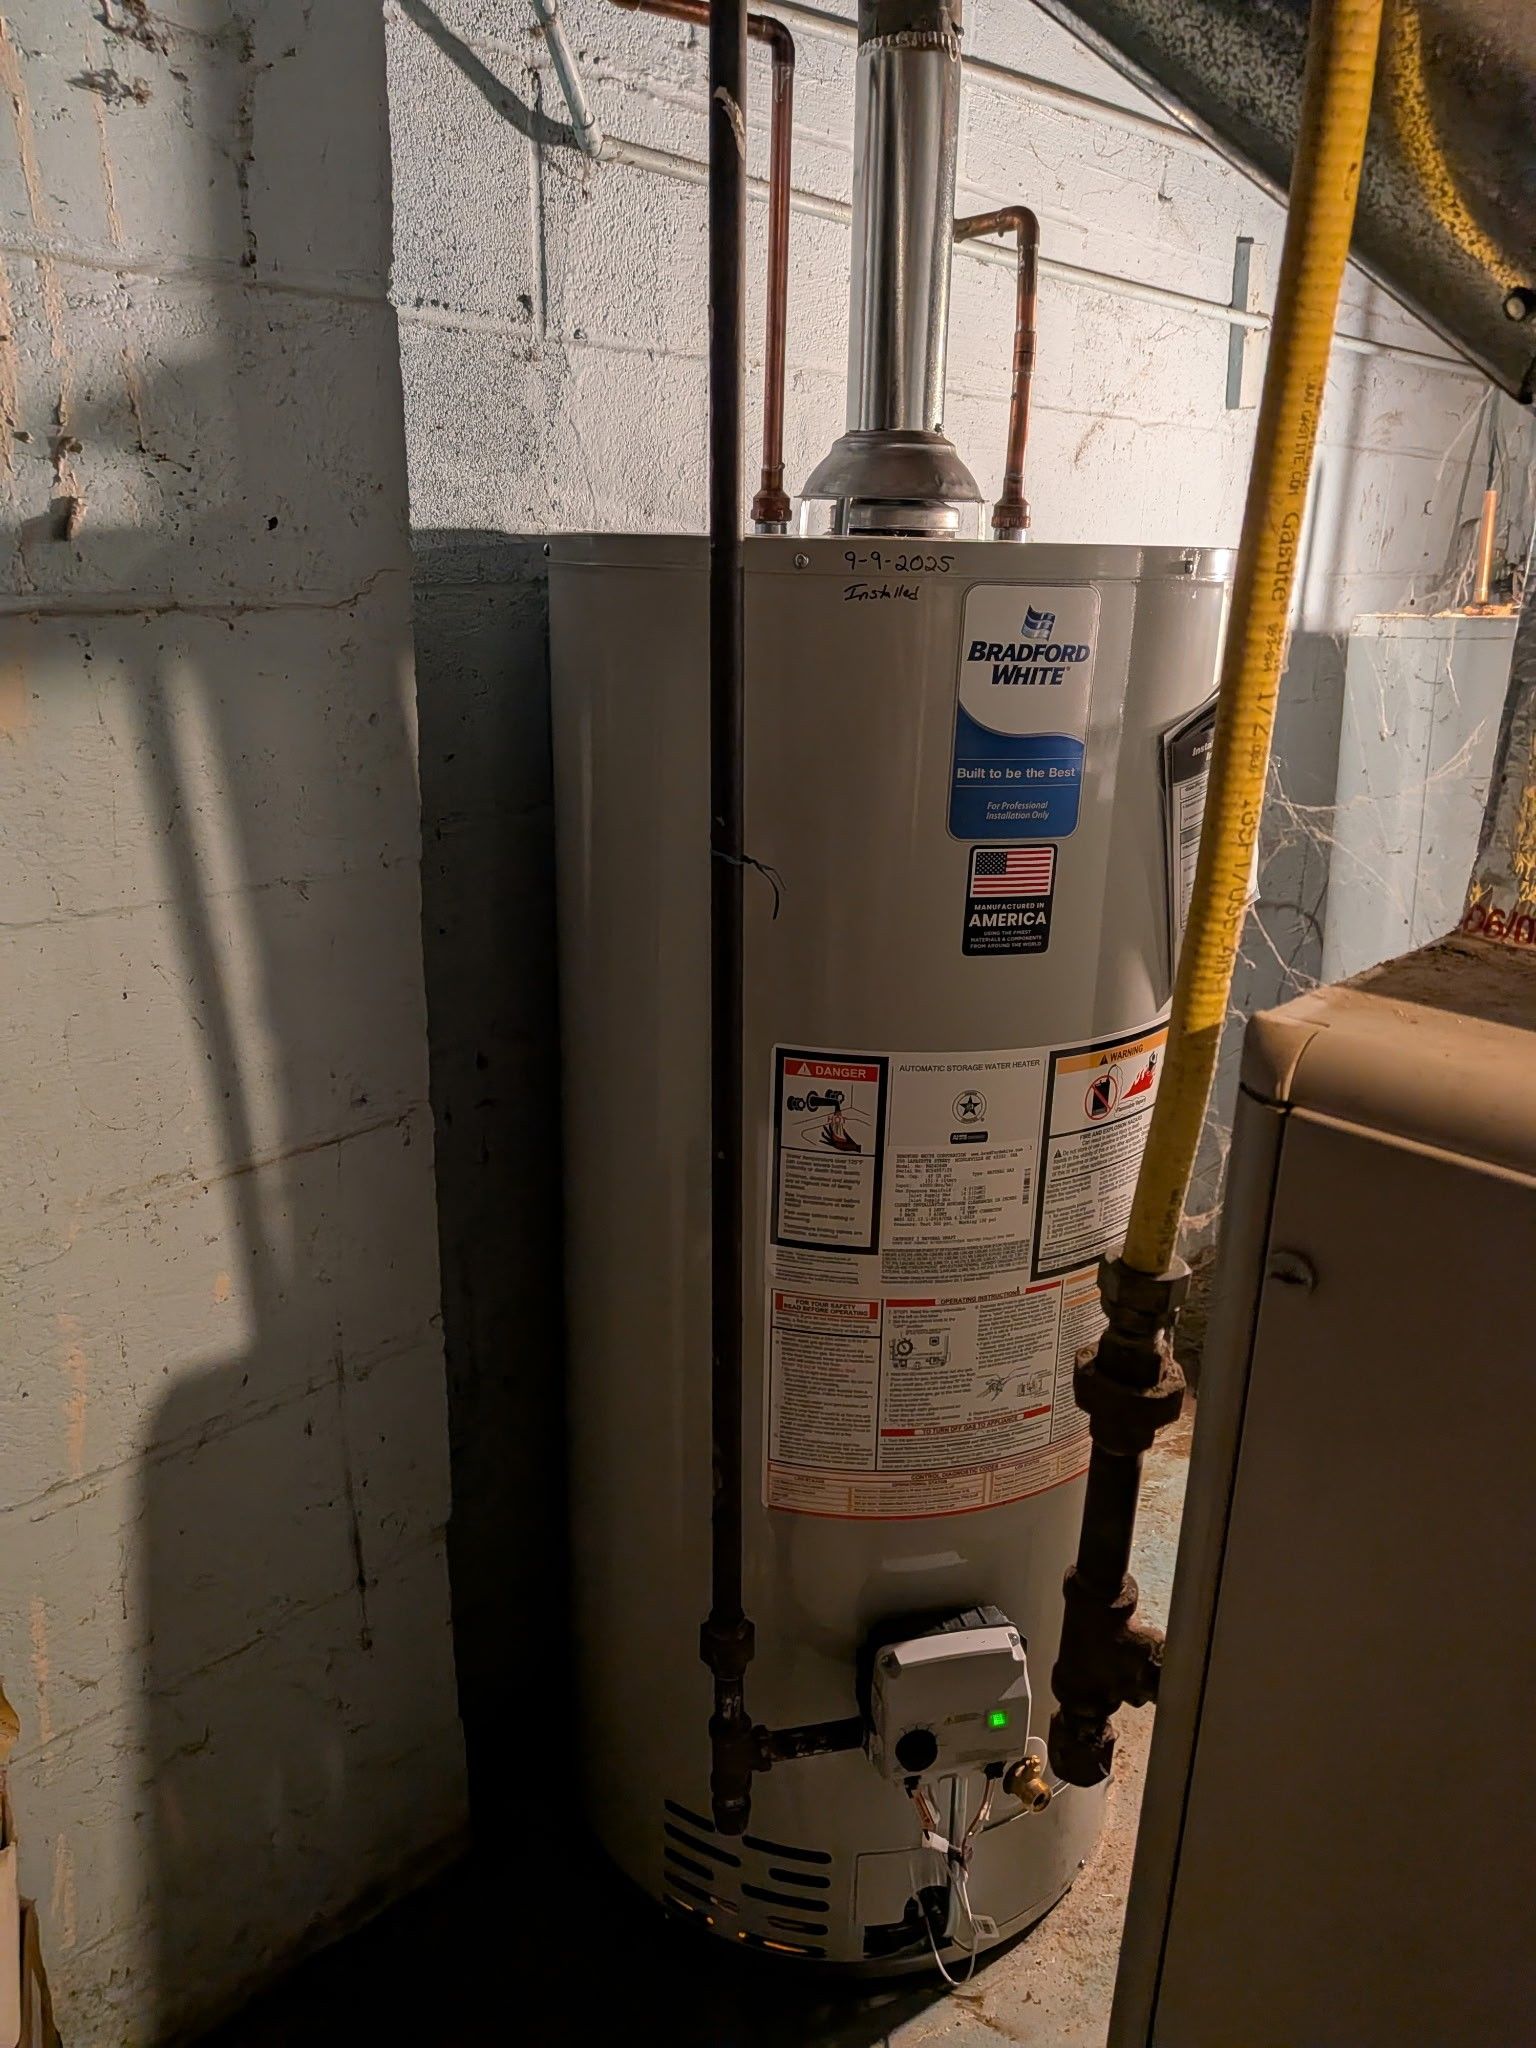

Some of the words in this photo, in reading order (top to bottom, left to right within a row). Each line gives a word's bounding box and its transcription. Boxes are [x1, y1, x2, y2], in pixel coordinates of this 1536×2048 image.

[844, 551, 954, 572] 9-9-2025
[844, 583, 919, 601] Installed
[967, 641, 1091, 662] BRADFORD
[991, 664, 1066, 685] WHITE
[957, 768, 986, 779] Built
[989, 768, 1002, 779] to
[1005, 767, 1022, 779] be
[1025, 767, 1045, 779] the
[1048, 767, 1076, 778] Best
[987, 801, 1000, 810] For
[1001, 800, 1049, 811] Professional
[986, 811, 1031, 820] Installation
[1032, 810, 1050, 821] Only
[968, 911, 1047, 928] AMERICA
[1110, 1044, 1144, 1060] WARNING
[899, 1065, 946, 1073] AUTOMATIC
[946, 1064, 984, 1072] STORAGE
[985, 1062, 1011, 1071] WATER
[1011, 1059, 1041, 1068] HEATER
[815, 1067, 867, 1080] DANGER
[827, 1114, 847, 1124] HOT
[1102, 1122, 1127, 1134] EXPLOSION
[940, 1296, 978, 1305] OPERATING
